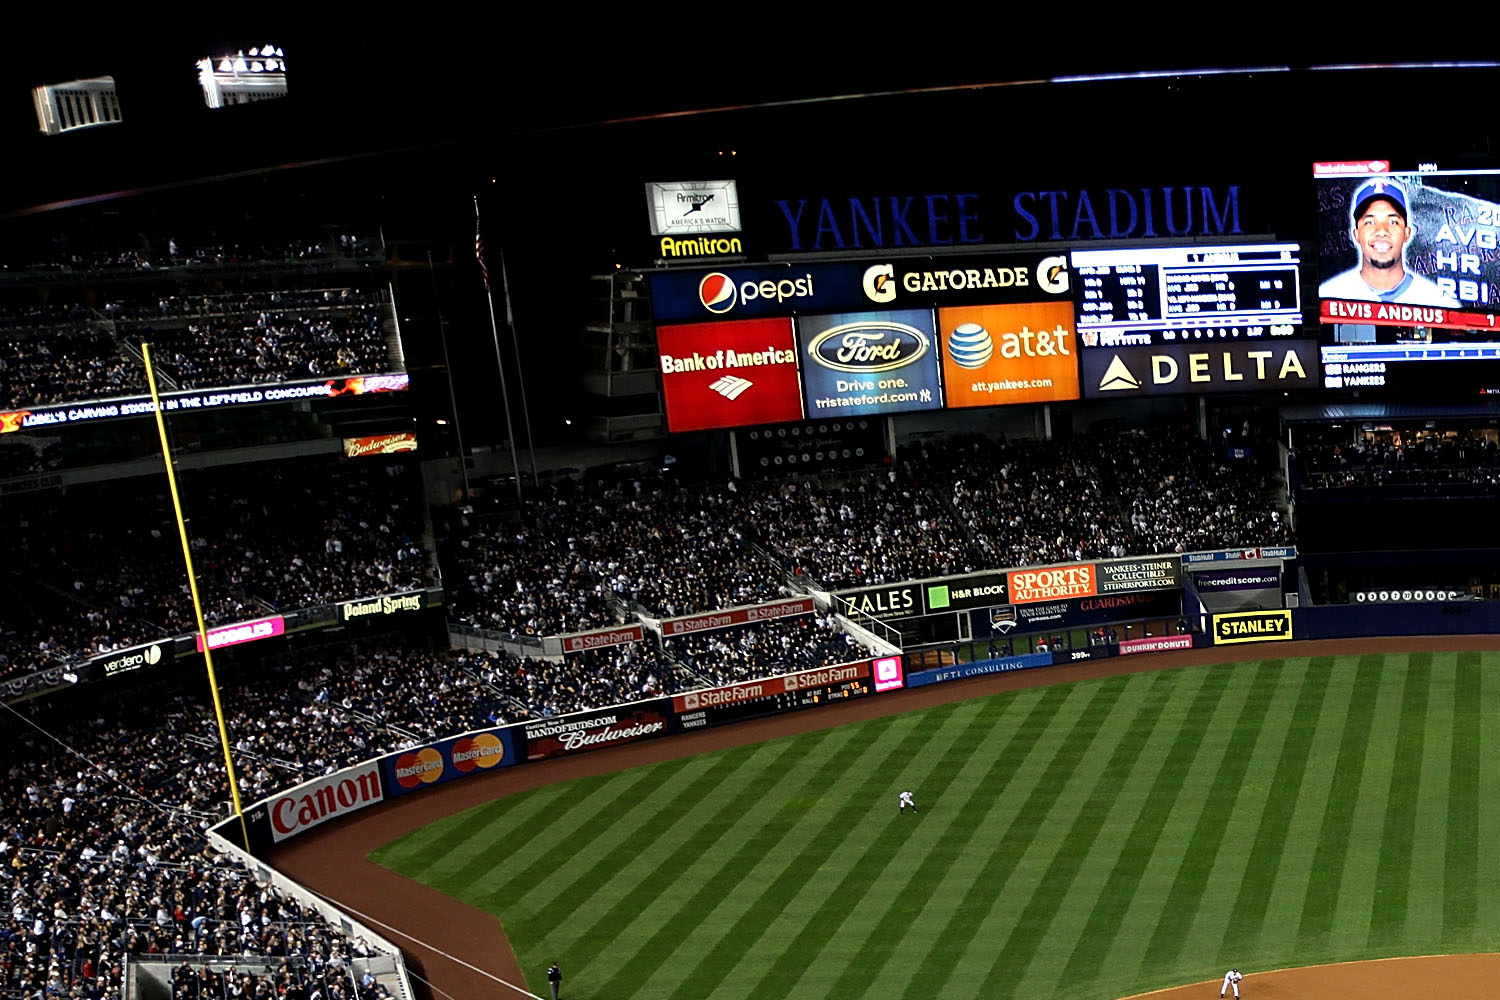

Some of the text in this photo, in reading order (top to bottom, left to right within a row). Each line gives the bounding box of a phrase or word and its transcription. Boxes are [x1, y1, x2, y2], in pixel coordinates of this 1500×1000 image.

[776, 186, 1243, 250] YANKEE STADIUM
[661, 237, 742, 256] Armitron
[1437, 250, 1481, 275] HR
[740, 273, 814, 306] pepsi
[862, 263, 897, 303] G
[903, 267, 1029, 293] GATORADE
[1036, 255, 1069, 294] G
[1437, 276, 1488, 303] RBI
[1329, 301, 1495, 327] ELVIS ANDRUS 1
[837, 332, 901, 363] Ford
[1001, 324, 1070, 359] at&t
[660, 346, 795, 374] Bank of America
[1152, 350, 1306, 385] DELTA
[836, 377, 908, 393] Drive one.
[971, 377, 1052, 394] att.yankees.com
[69, 405, 118, 420] CARVING
[166, 399, 178, 410] IN
[181, 397, 201, 408] THE
[265, 385, 332, 400] CONCOURSE
[815, 392, 917, 409] tristateford.com
[348, 433, 407, 457] Budweiser
[1013, 567, 1090, 590] SPORTS
[1104, 562, 1172, 574] YANKEES-STEINER
[1112, 570, 1165, 581] COLLECTIBLES
[952, 585, 1004, 599] H&R BLOCK
[1104, 578, 1175, 591] STEINERSPORTS.COM
[1198, 575, 1277, 587] freecreditscore.com
[343, 595, 421, 620] Poland Spring
[846, 589, 913, 616] ZALES
[1222, 618, 1284, 635] STANLEY
[1157, 640, 1190, 649] DONUTS
[104, 654, 143, 671] verdero
[965, 661, 1023, 676] CONSULTING
[527, 716, 617, 739] BANDOFBUDS.COM
[681, 711, 706, 722] RANGERS
[683, 718, 707, 728] YANKEES
[559, 721, 663, 750] Budweiser
[452, 745, 501, 764] MasterCard
[396, 759, 442, 779] MasterCard
[272, 770, 381, 834] Canon
